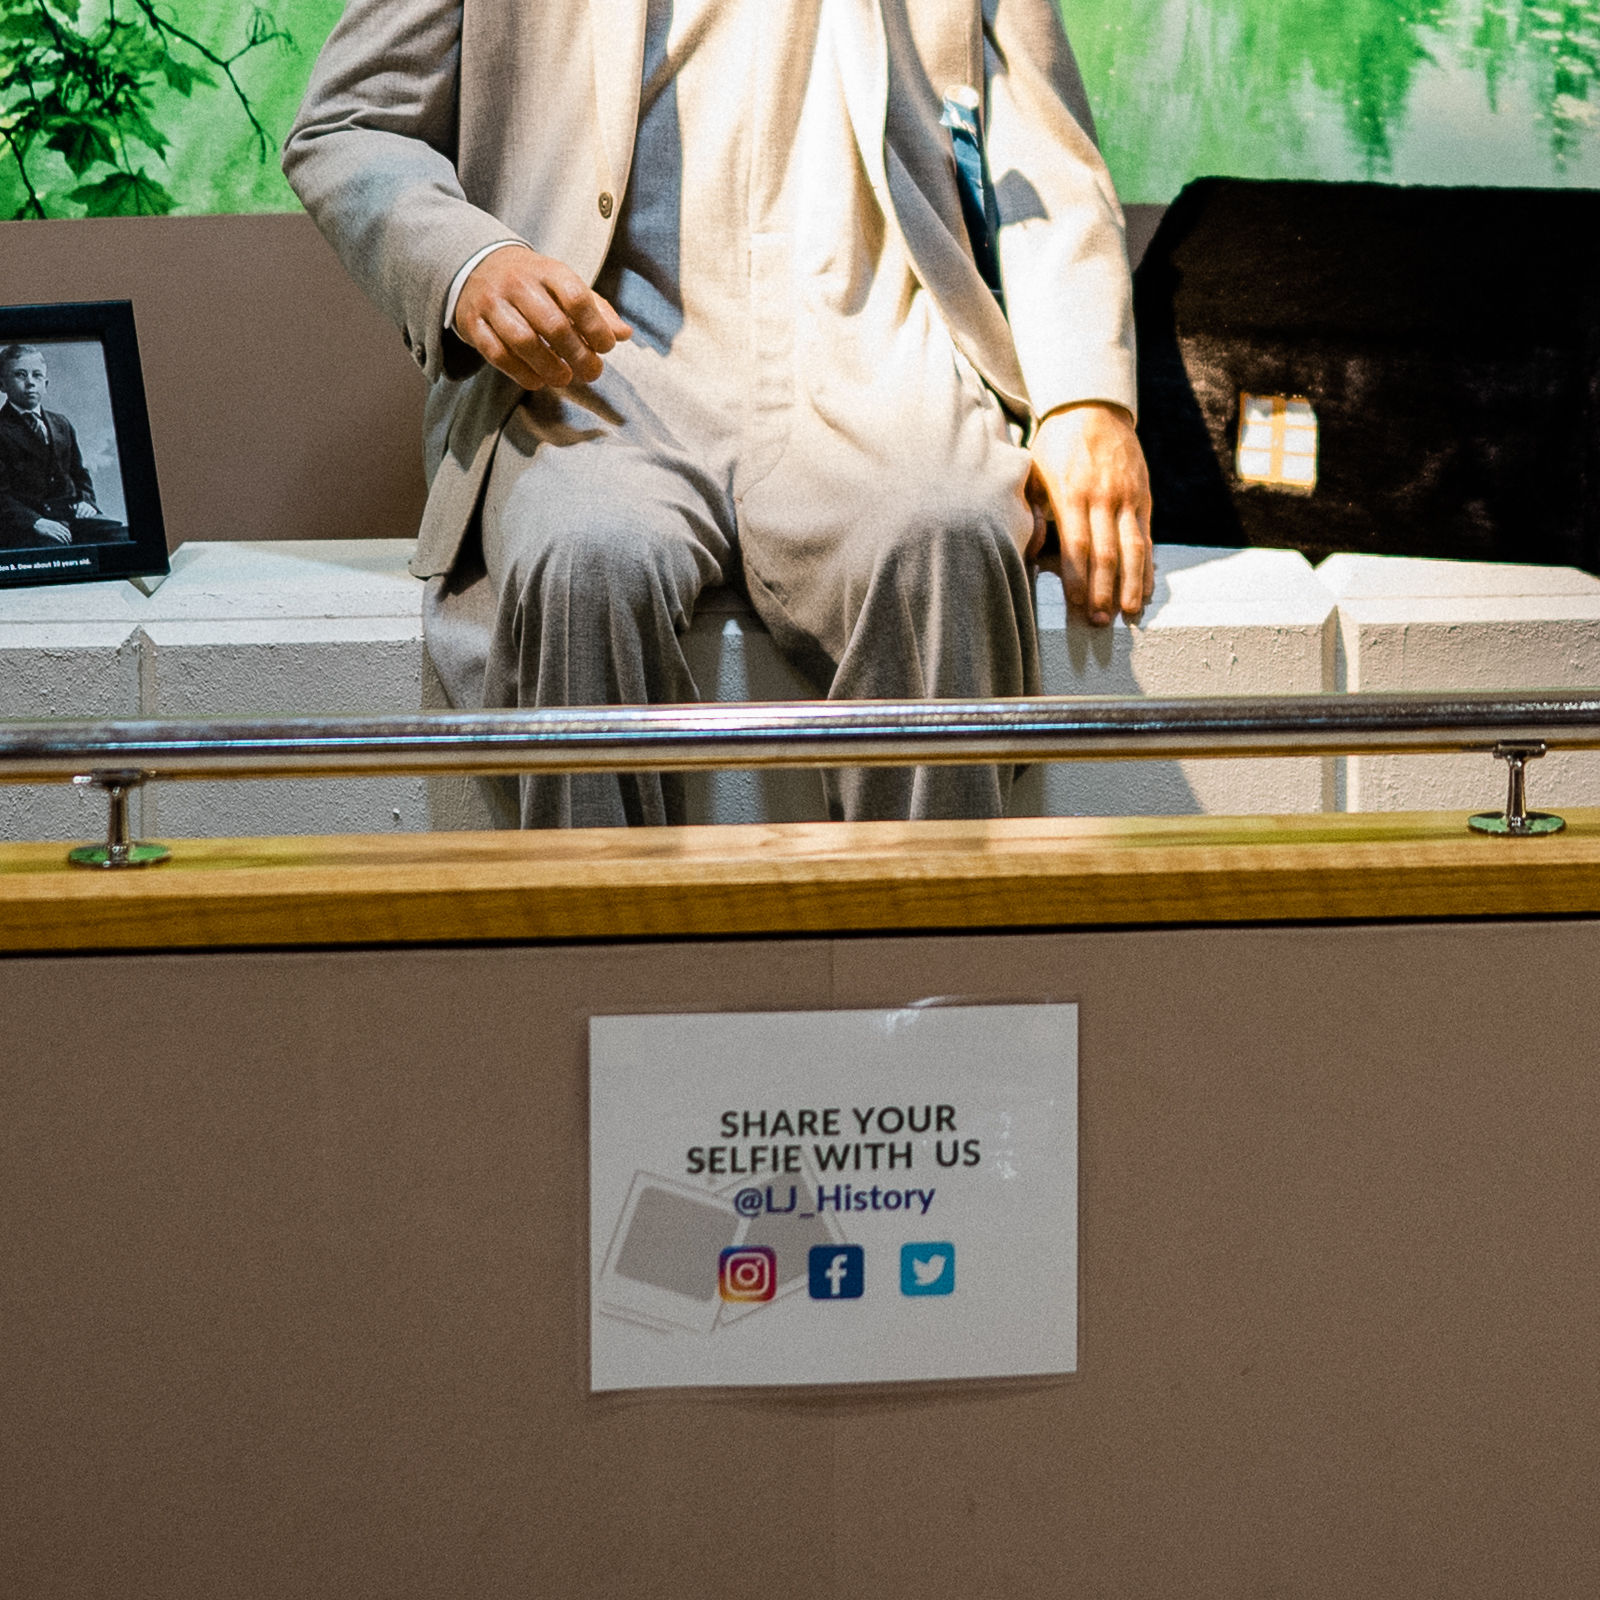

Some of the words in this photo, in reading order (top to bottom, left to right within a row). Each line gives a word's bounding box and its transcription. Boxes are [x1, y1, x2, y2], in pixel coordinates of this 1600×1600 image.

[18, 563, 33, 571] Dow
[33, 561, 52, 569] about
[62, 560, 79, 568] years
[720, 1108, 841, 1139] SHARE
[852, 1104, 958, 1134] YOUR
[686, 1145, 802, 1175] SELFIE
[814, 1142, 914, 1172] WITH
[935, 1138, 982, 1168] US
[733, 1184, 937, 1220] @LJ_History
